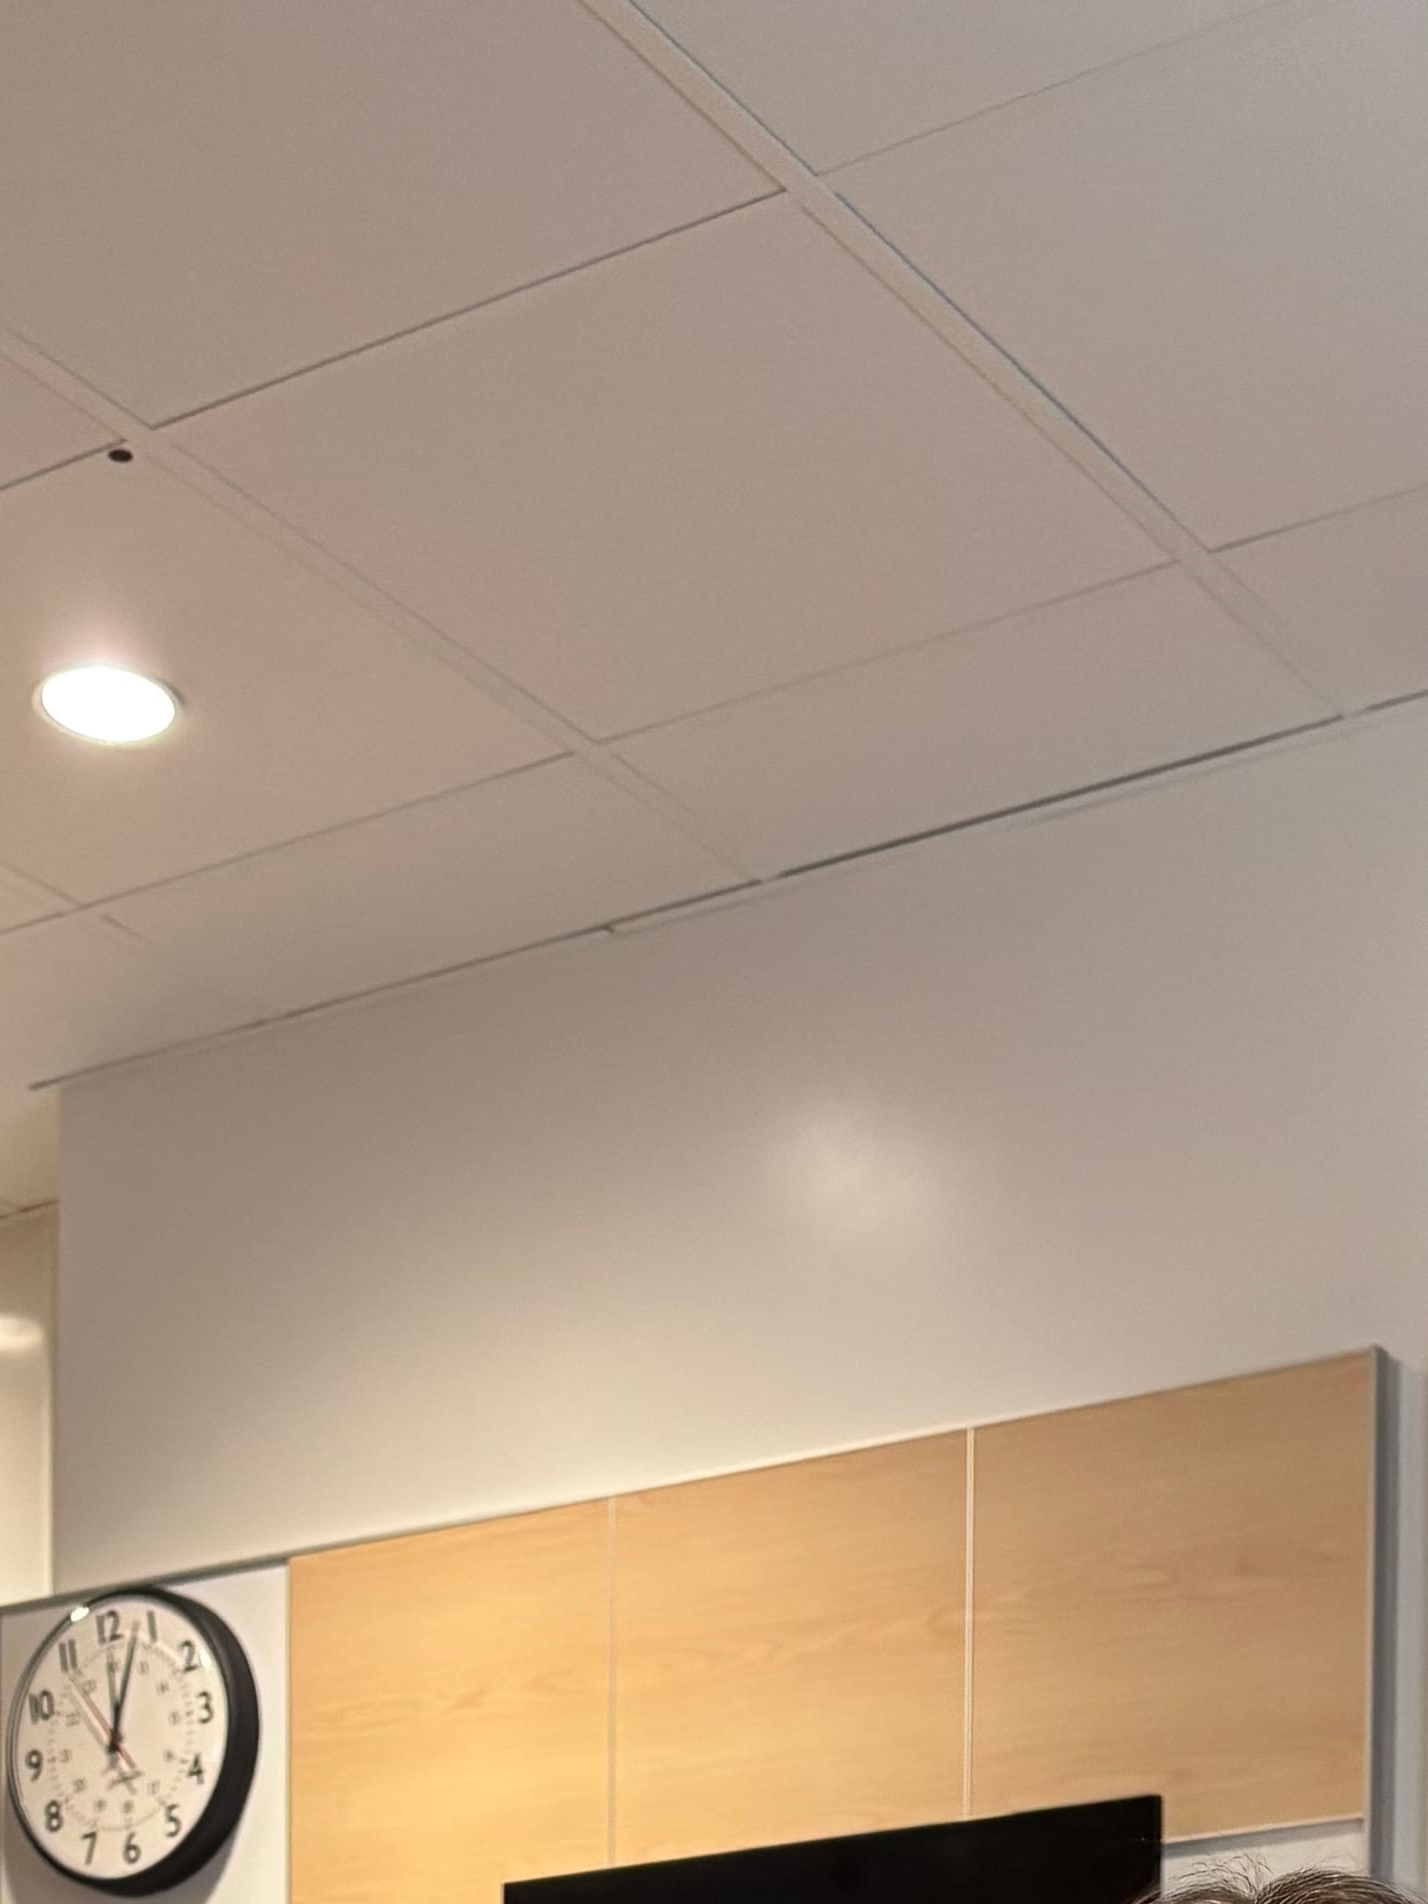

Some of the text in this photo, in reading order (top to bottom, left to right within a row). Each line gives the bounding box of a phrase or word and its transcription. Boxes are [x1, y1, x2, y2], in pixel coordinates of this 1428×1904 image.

[95, 1610, 124, 1645] 12
[146, 1611, 158, 1644] 1
[58, 1639, 80, 1675] 11
[180, 1640, 198, 1672] 2
[28, 1690, 55, 1725] 10
[197, 1691, 214, 1724] 3
[25, 1749, 44, 1782] 9
[187, 1752, 204, 1785] 4
[44, 1800, 63, 1833] 8
[164, 1803, 181, 1837] 5
[81, 1831, 97, 1865] 7
[122, 1832, 141, 1864] 6
